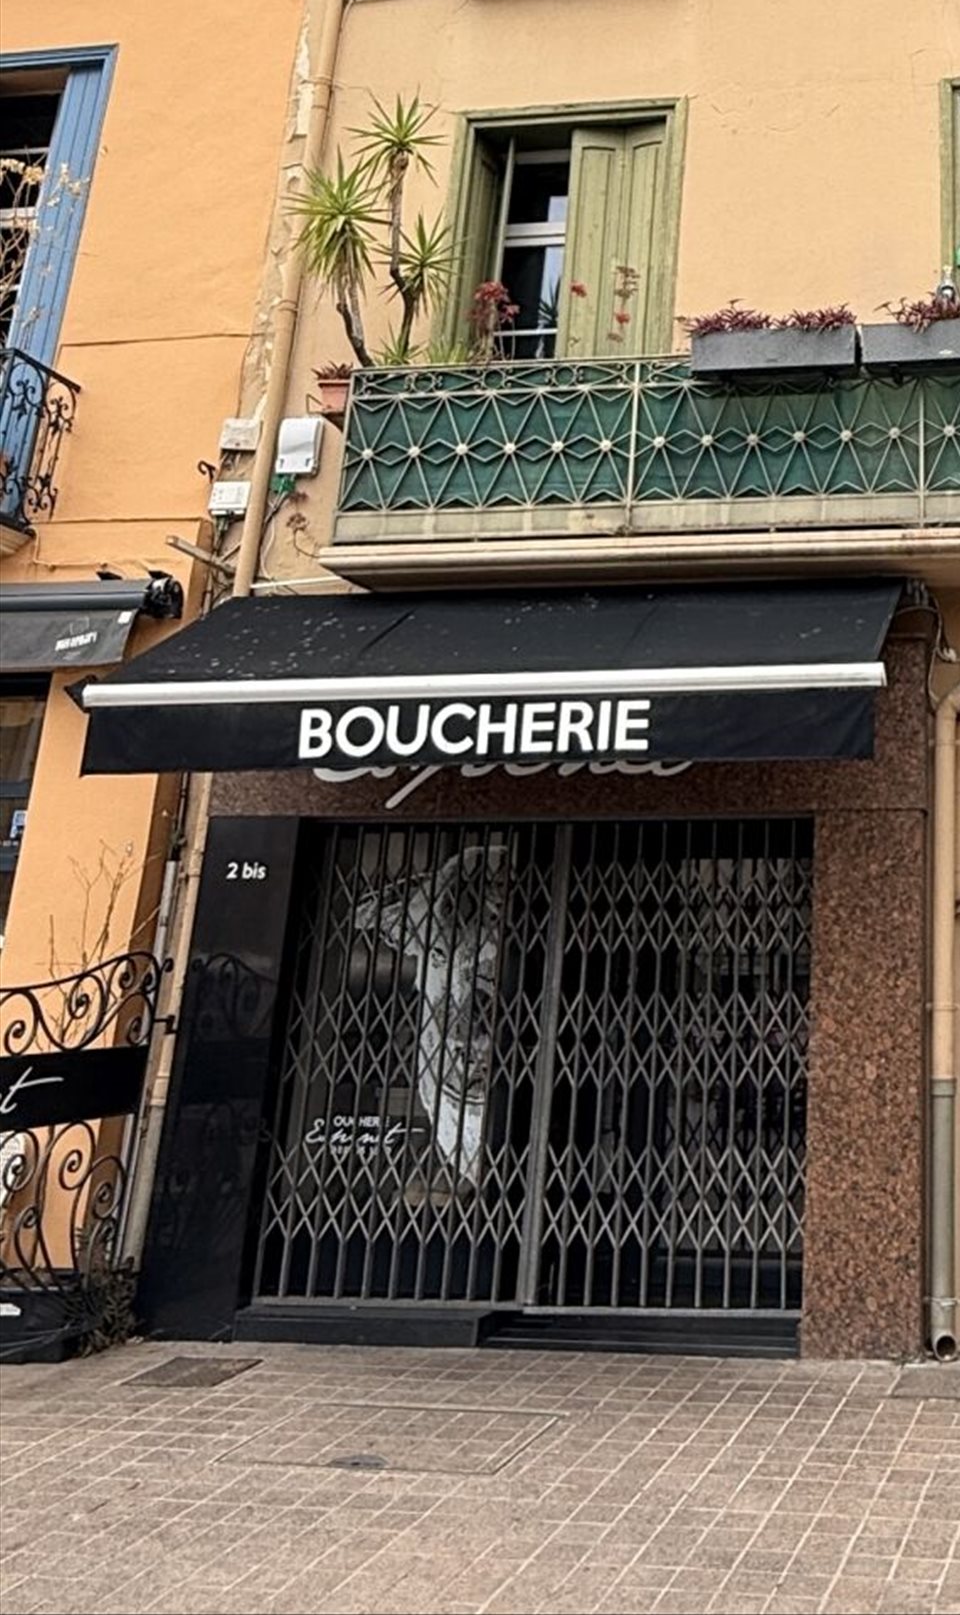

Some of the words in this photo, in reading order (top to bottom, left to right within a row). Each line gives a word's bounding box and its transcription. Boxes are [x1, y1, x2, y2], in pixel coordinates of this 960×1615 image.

[298, 699, 651, 759] BOUCHERIE
[226, 861, 239, 879] 2
[242, 861, 267, 880] bis
